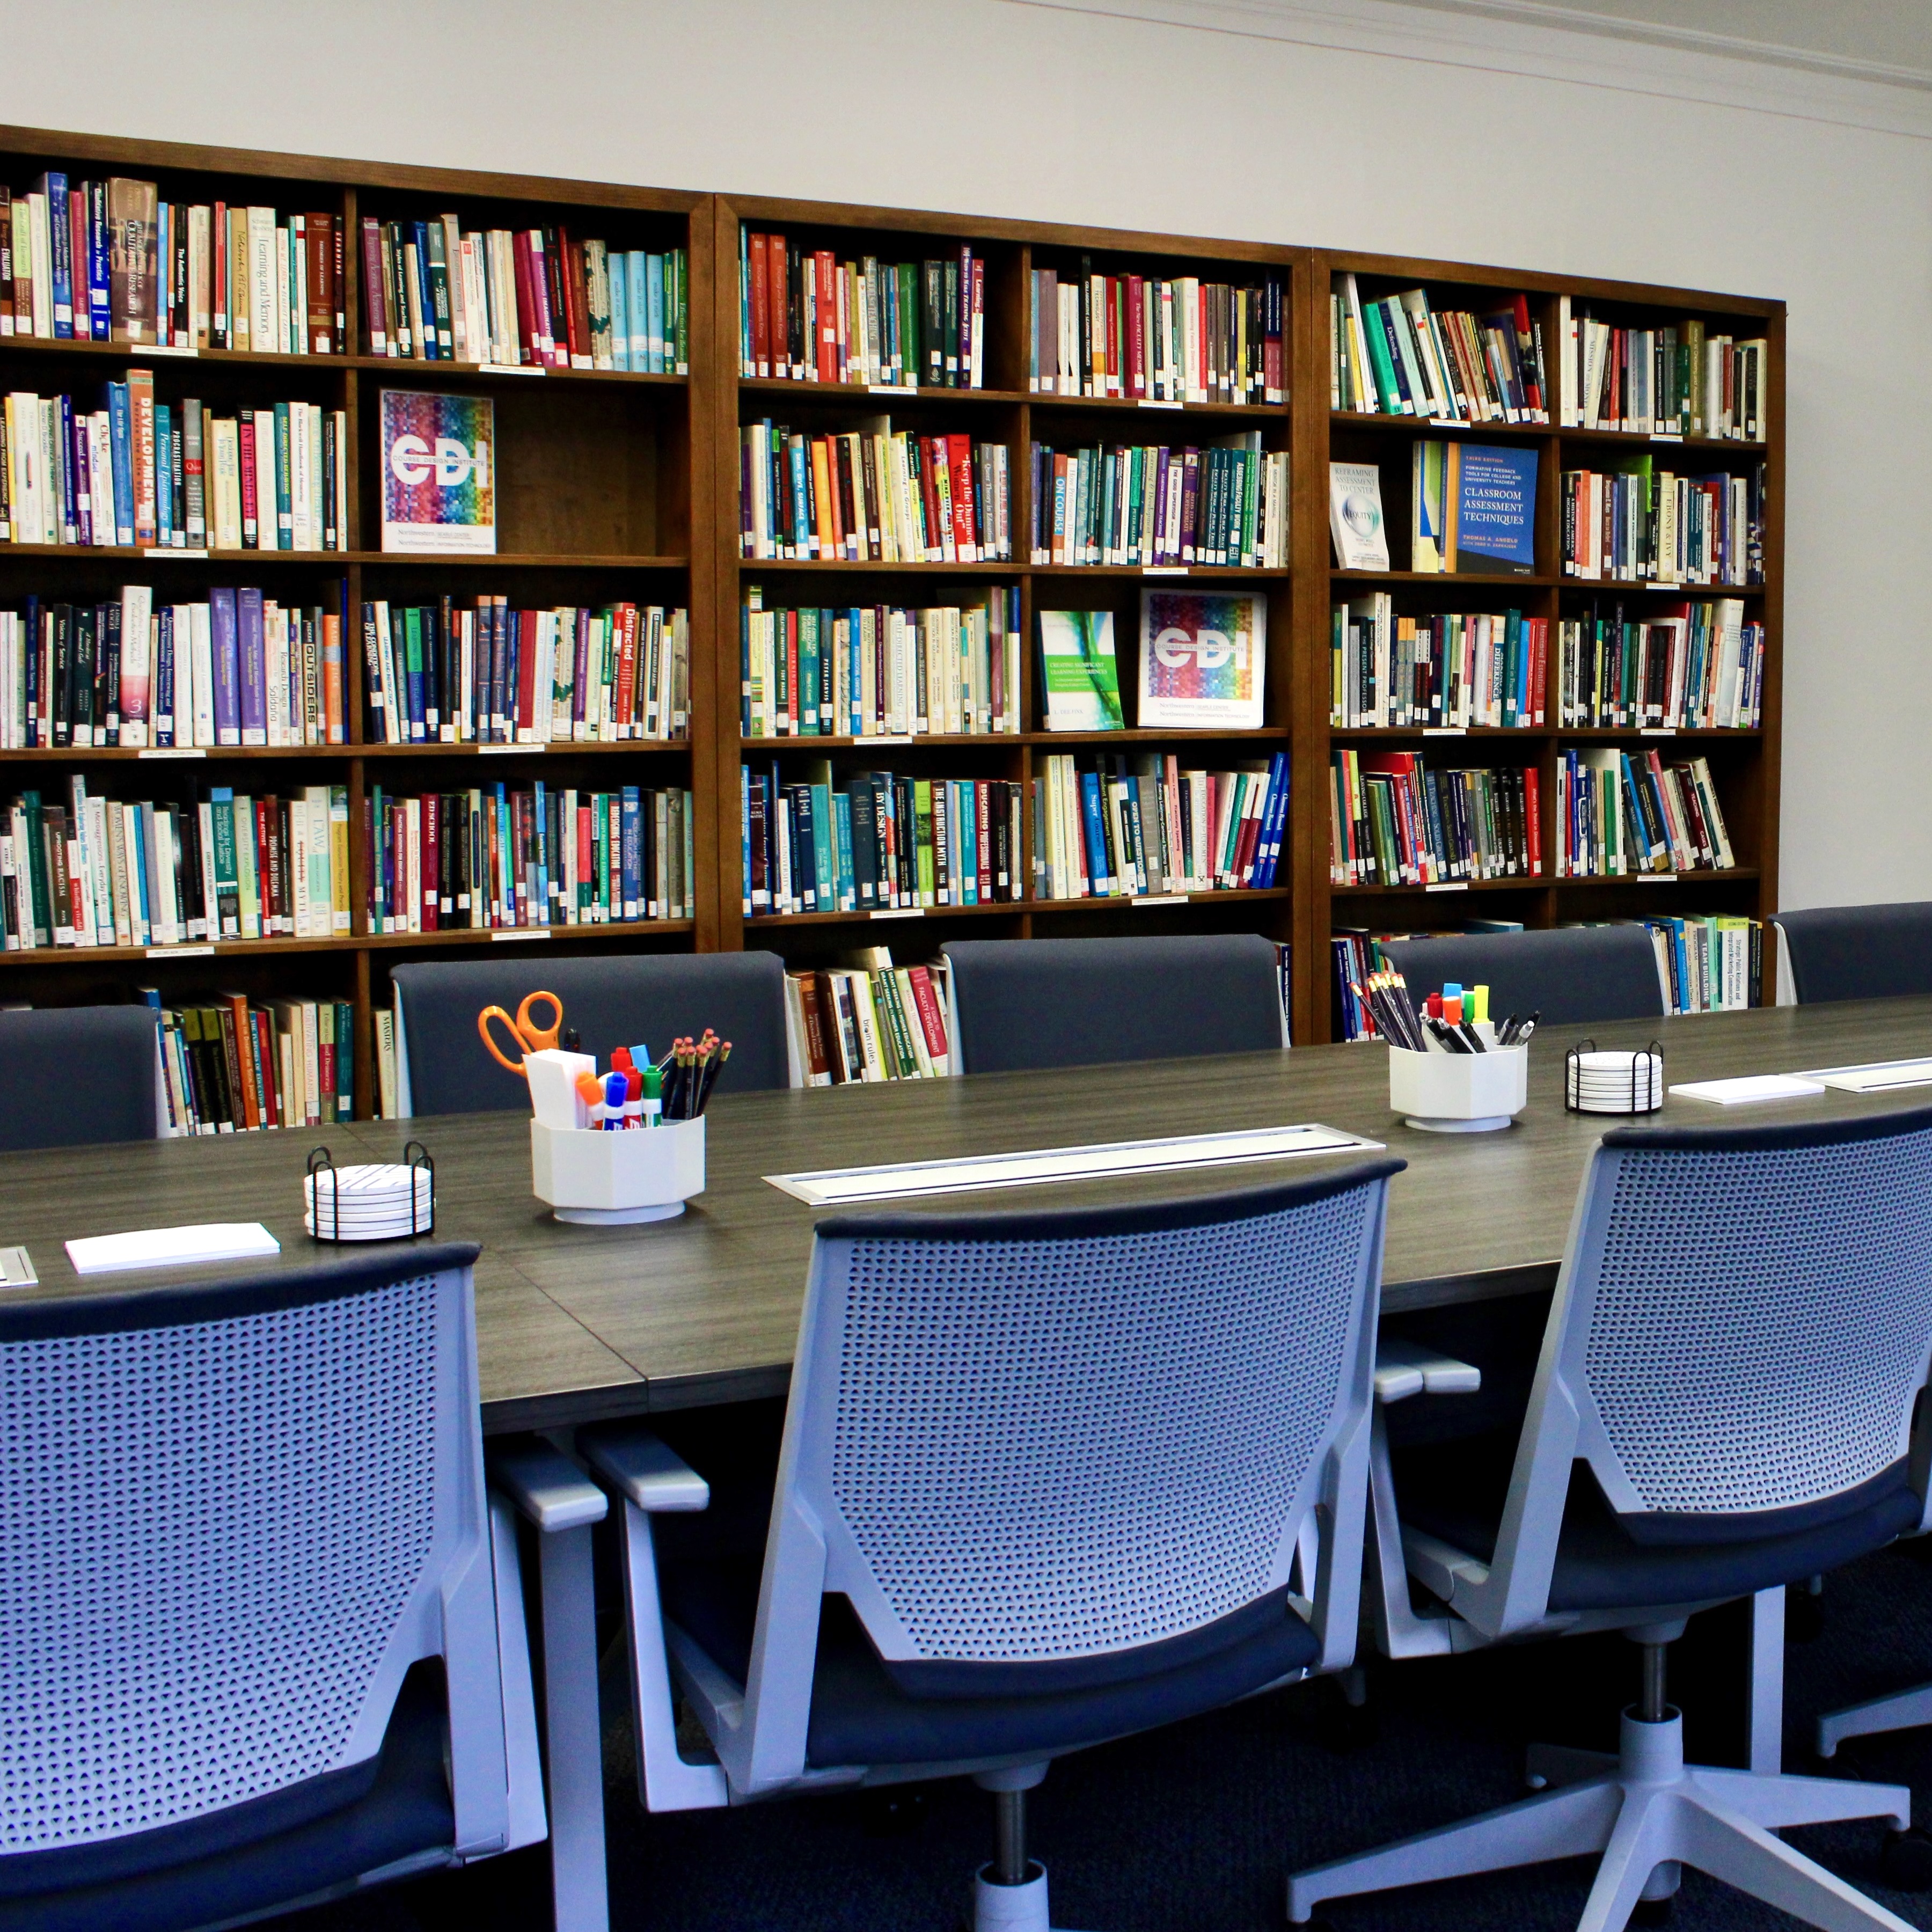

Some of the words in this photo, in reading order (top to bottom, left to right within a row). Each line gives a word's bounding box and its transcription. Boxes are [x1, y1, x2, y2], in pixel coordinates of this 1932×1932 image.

[2, 248, 11, 281] EVALUATOR
[257, 239, 270, 278] Learning
[260, 280, 269, 296] and
[258, 298, 270, 334] Memory
[1387, 326, 1398, 360] Defending
[1587, 340, 1596, 372] MISSION
[141, 398, 153, 509] DEVELOPMENT
[160, 433, 169, 468] Personal
[173, 431, 181, 486] PROCRASTINATION
[391, 434, 488, 488] CDI
[452, 458, 485, 466] INSTITUTE
[953, 465, 961, 500] Women
[1056, 478, 1065, 494] ON
[1236, 462, 1244, 491] ASSESSING
[1335, 467, 1374, 478] REFRAMING
[1336, 476, 1375, 486] ASSESSMENT
[161, 471, 169, 522] Epistemology
[964, 487, 972, 502] the
[1350, 485, 1374, 495] CENTER
[1465, 487, 1521, 500] CLASSROOM
[1055, 496, 1064, 535] COURSE
[1350, 511, 1371, 519] EQUITY
[1463, 512, 1524, 525] TECHNIQUES
[1464, 500, 1524, 511] ASSESSMENT
[965, 503, 975, 544] Damned
[624, 609, 635, 660] Distracted
[1155, 627, 1247, 670] CDI
[306, 646, 316, 723] OUTSIDERS
[1537, 660, 1546, 693] Essentials
[280, 684, 288, 707] Design
[428, 801, 434, 813] ED
[876, 792, 885, 804] BY
[935, 787, 945, 800] THE
[1691, 793, 1700, 817] TEACHING
[611, 806, 619, 838] REDESIGNING
[876, 806, 886, 838] DESIGN
[935, 801, 946, 845] INSTRUCTION
[1102, 798, 1111, 836] Engagement
[1134, 825, 1140, 835] TO
[93, 811, 103, 861] Microaggressions
[268, 836, 277, 859] PROMISE
[979, 831, 990, 869] PROFESSIONALS
[270, 860, 278, 872] AND
[611, 841, 620, 868] EDUCATION
[938, 847, 947, 866] MYTH
[57, 868, 65, 896] RACISM
[97, 866, 105, 892] Everyday
[270, 873, 279, 897] DILEMMA
[73, 882, 81, 909] whistling
[918, 987, 928, 1011] FACULTY
[924, 1013, 939, 1052] DEVELOPMENT
